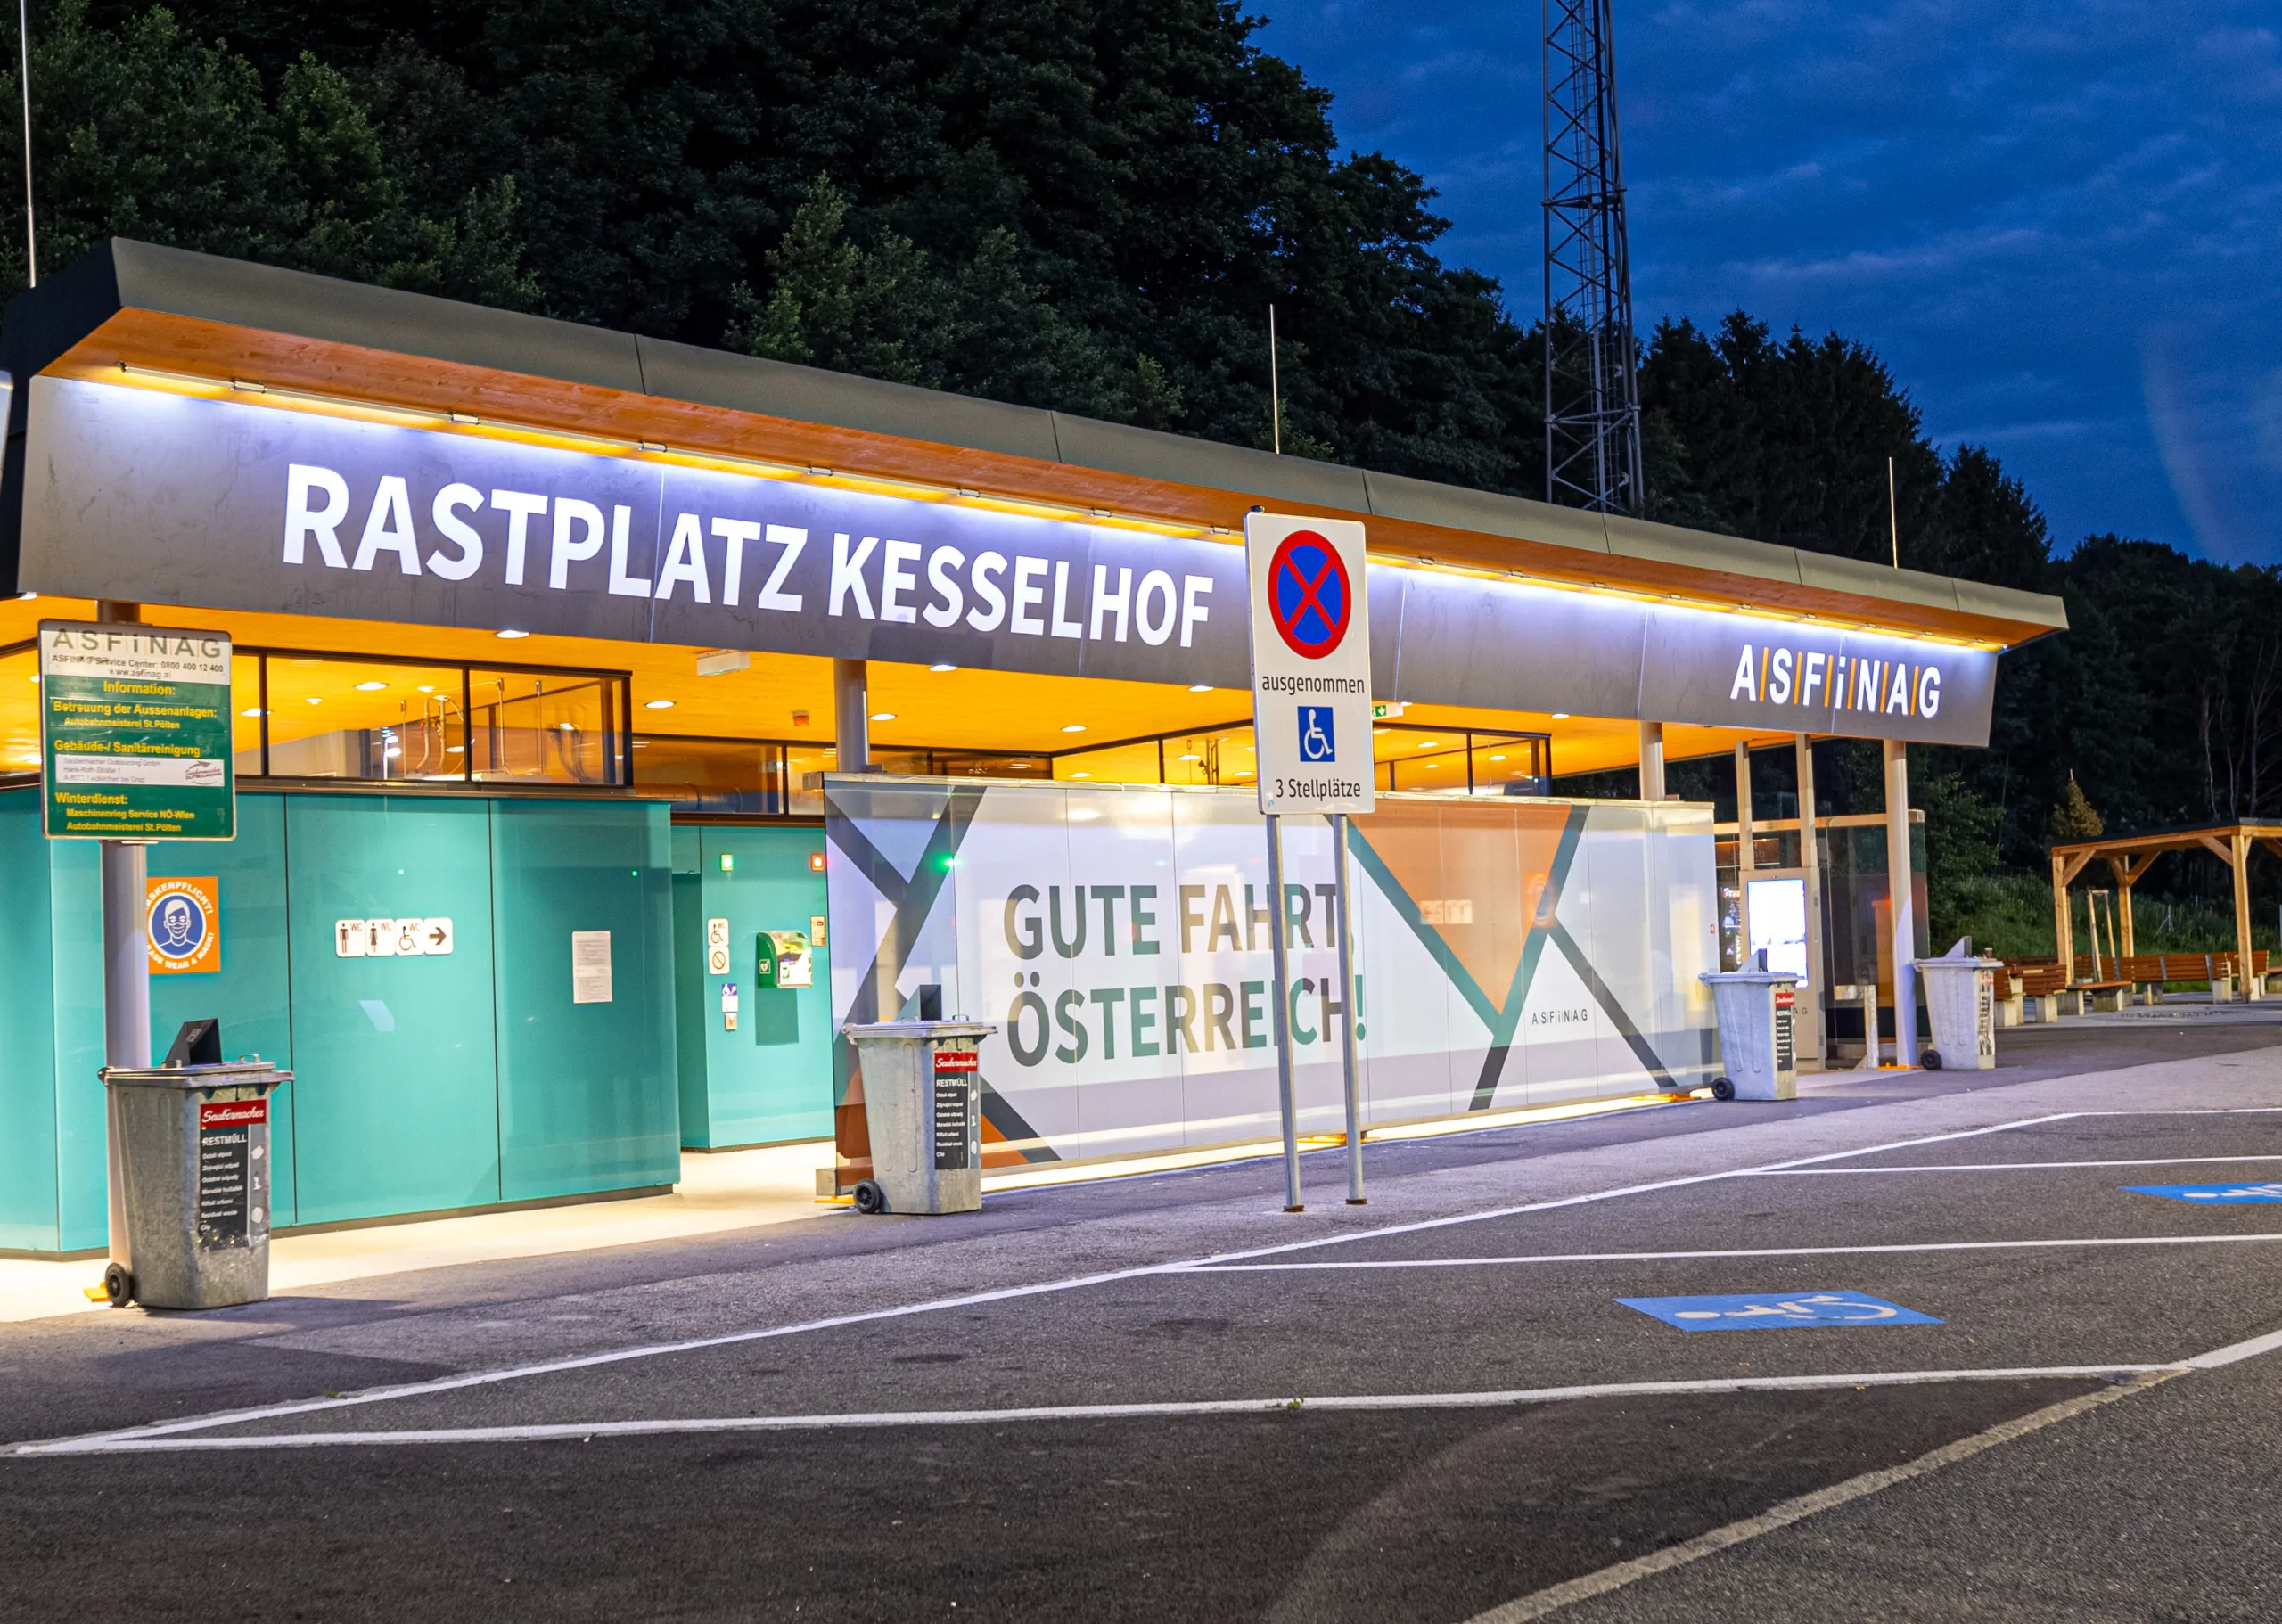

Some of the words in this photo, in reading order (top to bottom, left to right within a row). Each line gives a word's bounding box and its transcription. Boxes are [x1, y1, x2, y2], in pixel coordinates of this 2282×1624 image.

[283, 463, 808, 612] RASTPLATZ
[828, 532, 1213, 648] KESSELHOF
[128, 660, 158, 668] Center:
[161, 661, 180, 670] 0800
[183, 663, 196, 671] 400
[200, 663, 208, 672] 12
[210, 664, 224, 673] 400
[109, 669, 171, 679] www.asfinag.at
[103, 681, 176, 695] Information:
[1262, 676, 1365, 695] ausgenommen
[53, 701, 111, 716] Betreuung
[114, 703, 130, 714] der
[134, 704, 217, 719] Aussenanlagen:
[64, 717, 142, 728] Autobahnmeisterei
[54, 740, 111, 752] Gebäude-/
[113, 742, 201, 758] Sanitärreinigung
[1276, 778, 1284, 798] 3
[1289, 778, 1361, 801] Stellplätze
[55, 792, 128, 804] Winterdienst:
[66, 808, 127, 819] Maschinenring
[128, 809, 158, 818] Service
[160, 809, 194, 819] NÖ-Wien
[66, 822, 144, 831] Autobahnmeisterei
[145, 881, 214, 915] ASKENPFLICHT!
[350, 922, 362, 931] WC
[381, 922, 392, 931] WC
[409, 923, 421, 931] WC
[1004, 883, 1160, 960] GUTE
[1007, 971, 1366, 1067] ÖSTERREICH!
[936, 1078, 968, 1087] RESTMÜLL
[202, 1106, 265, 1123] Saubermacher
[202, 1133, 248, 1146] RESTMÜLL
